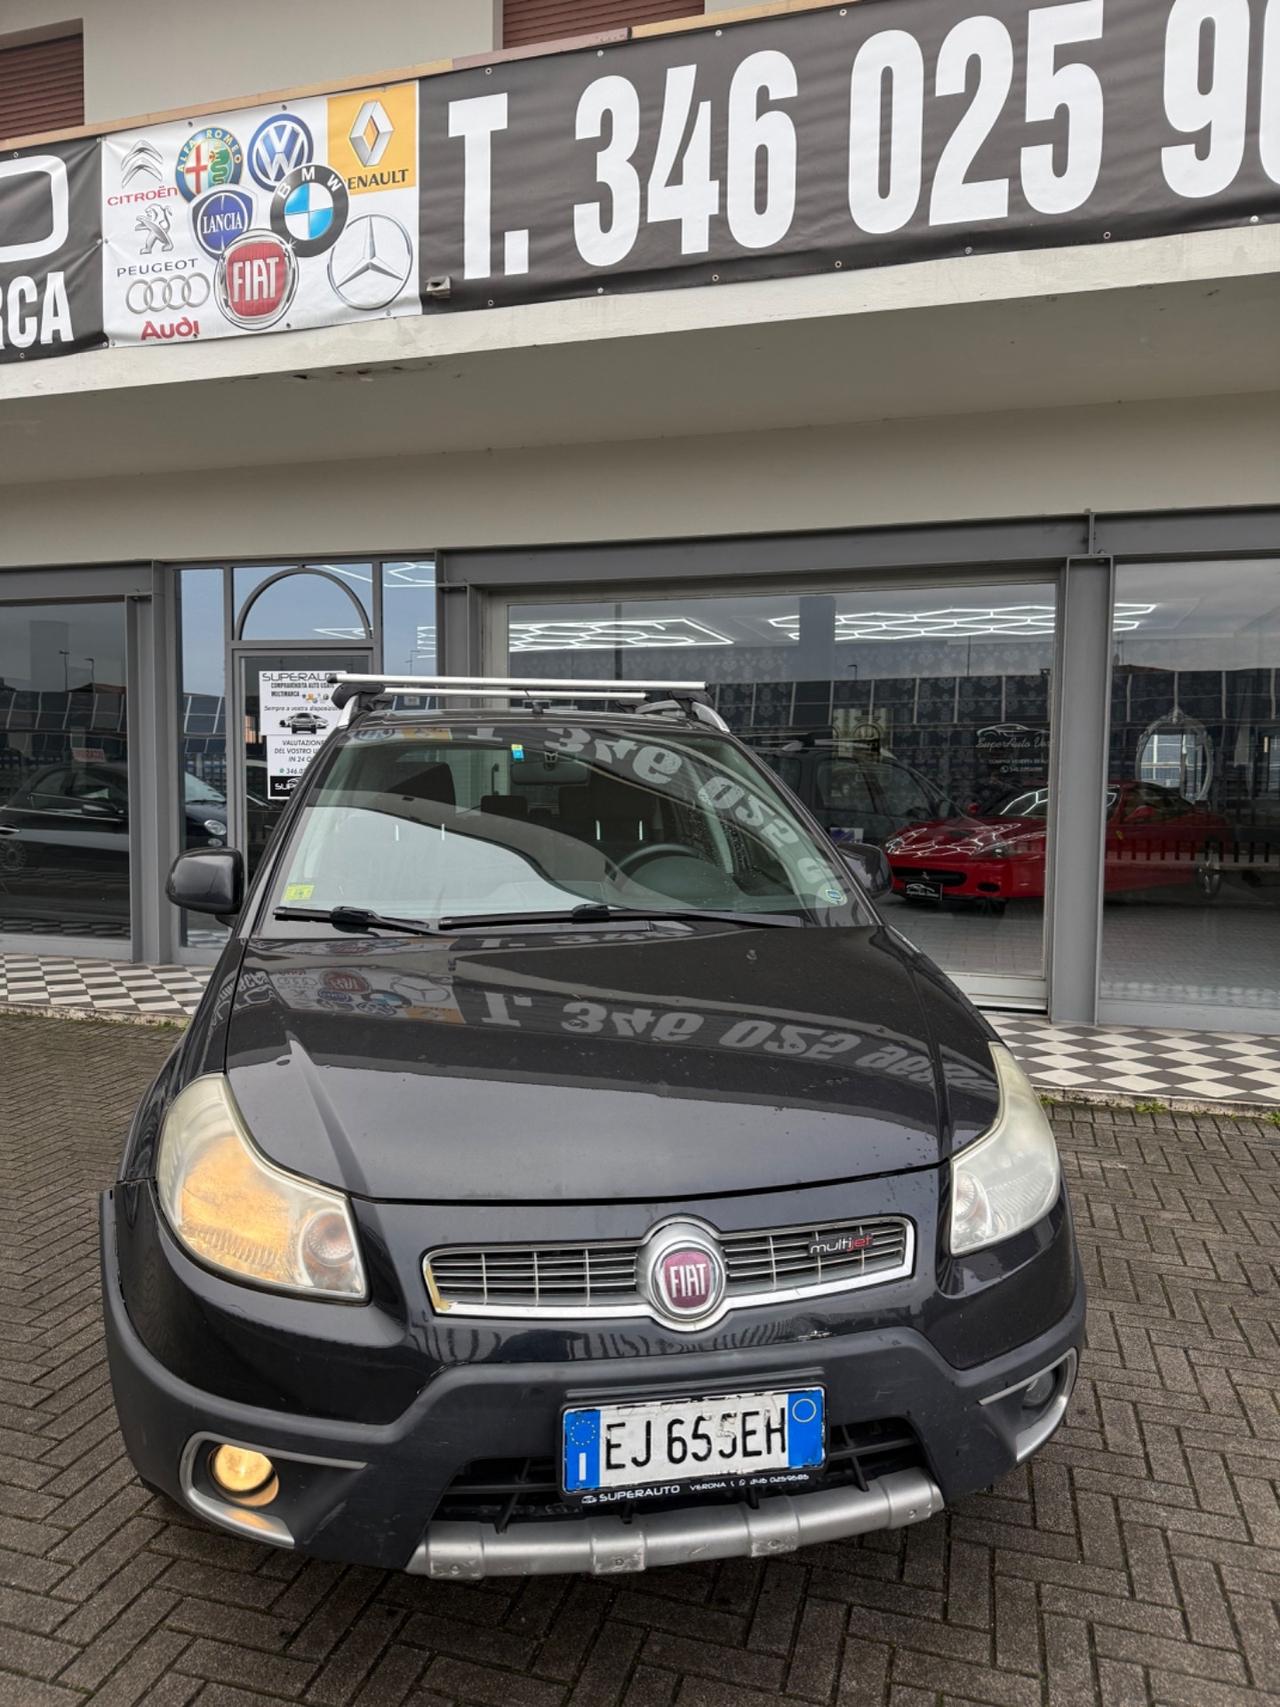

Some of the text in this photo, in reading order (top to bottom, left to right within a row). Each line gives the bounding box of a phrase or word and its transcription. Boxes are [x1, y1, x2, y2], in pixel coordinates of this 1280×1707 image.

[177, 129, 243, 173] ALFA ROMEO
[448, 0, 1280, 280] T. 346 025 9
[277, 166, 343, 199] BMW
[345, 169, 409, 190] ENAULT
[203, 211, 243, 234] LANCIA
[117, 258, 199, 278] PEUGEOT
[232, 256, 280, 303] FIAT
[140, 316, 200, 341] Audi
[809, 1234, 873, 1254] multijet
[669, 1263, 707, 1299] FIAT
[605, 1420, 652, 1470] EJ
[599, 1484, 681, 1502] SUPERAUTO
[690, 1481, 727, 1491] VERONA
